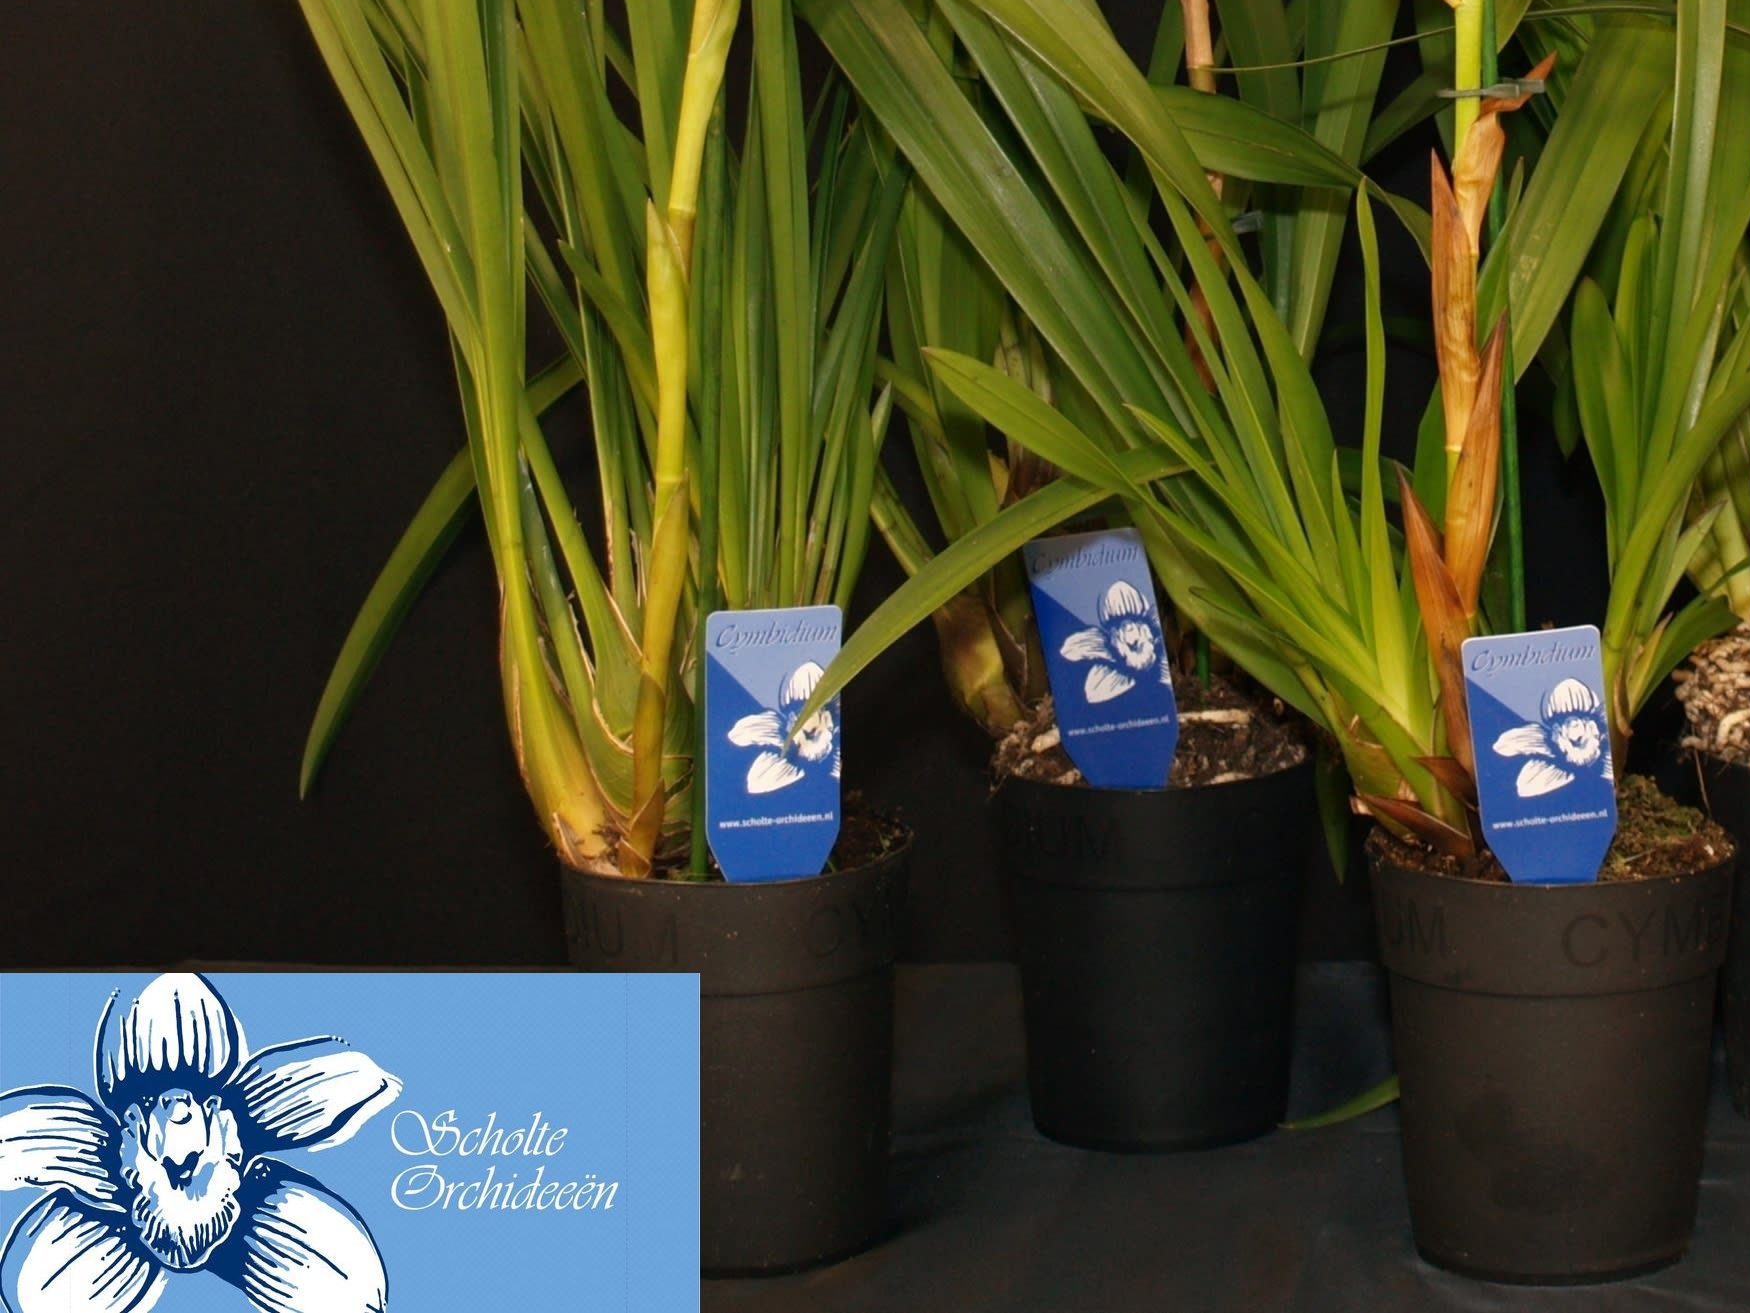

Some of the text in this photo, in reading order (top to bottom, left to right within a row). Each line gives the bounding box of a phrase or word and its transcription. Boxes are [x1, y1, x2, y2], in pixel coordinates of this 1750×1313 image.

[716, 619, 838, 656] Cymbidium
[1471, 641, 1596, 677] Cymbidium
[718, 810, 834, 830] www.scholte-orchideeen.nl
[1492, 808, 1608, 830] www.scholte-orchideeen.nl
